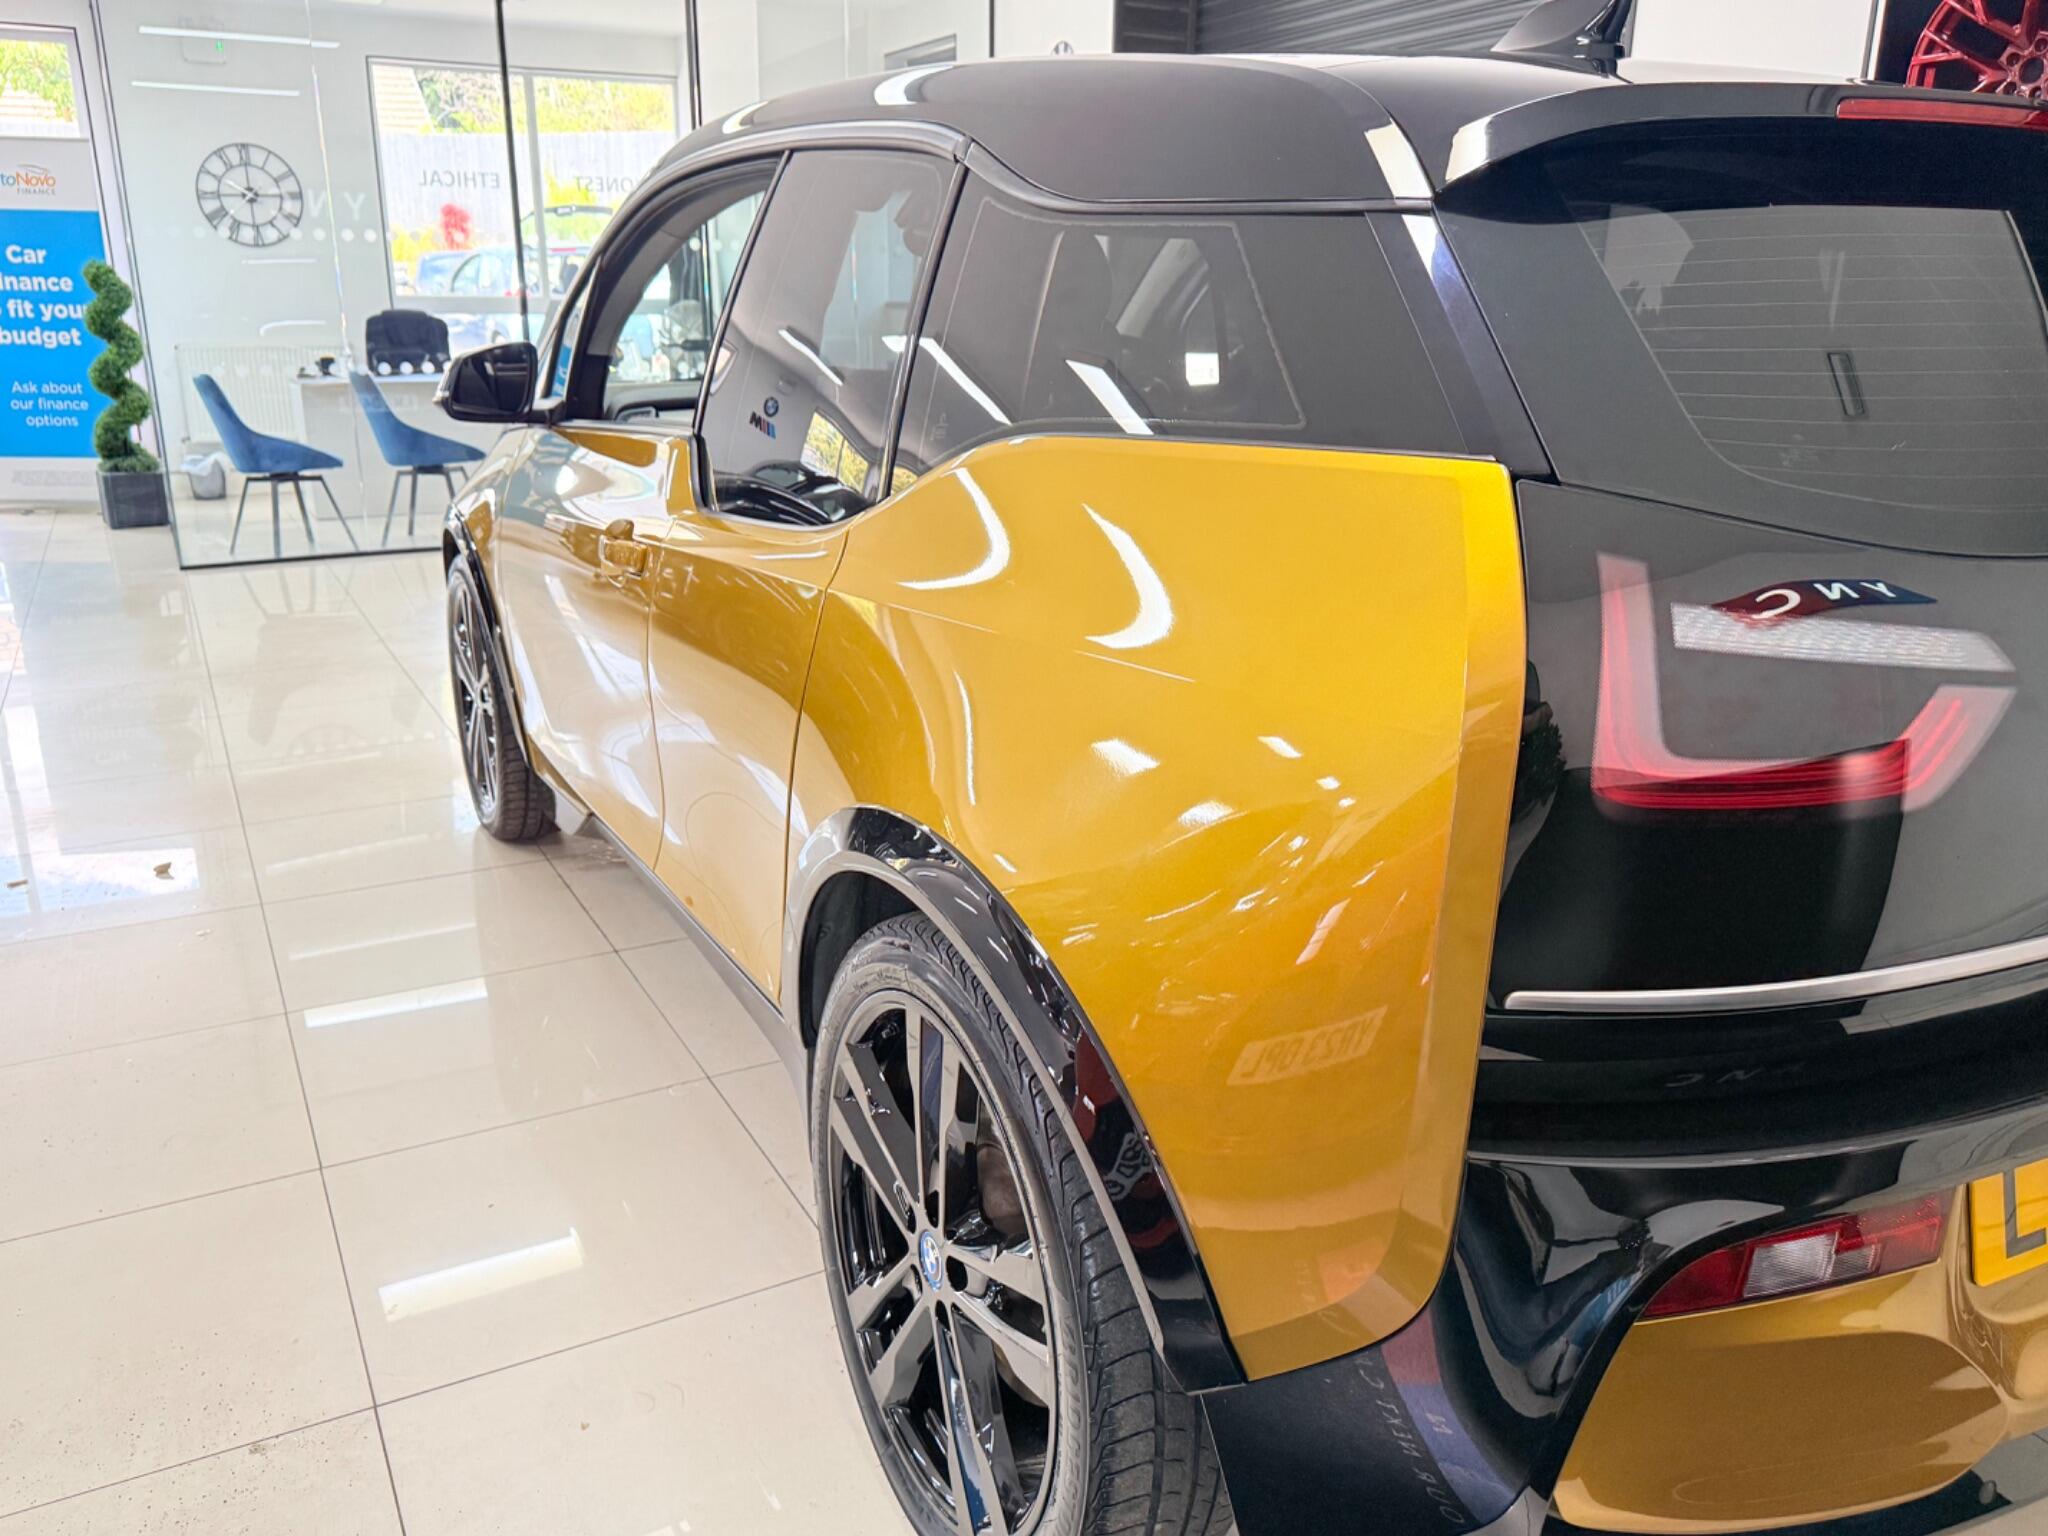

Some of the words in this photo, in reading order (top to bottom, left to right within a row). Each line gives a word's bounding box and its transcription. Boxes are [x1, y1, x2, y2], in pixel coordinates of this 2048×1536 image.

[5, 244, 47, 264] Car
[7, 298, 35, 318] fit
[0, 326, 82, 349] budget
[11, 380, 38, 395] Ask
[41, 380, 83, 395] about
[10, 399, 34, 411] our
[38, 396, 90, 411] finance
[25, 414, 80, 429] options
